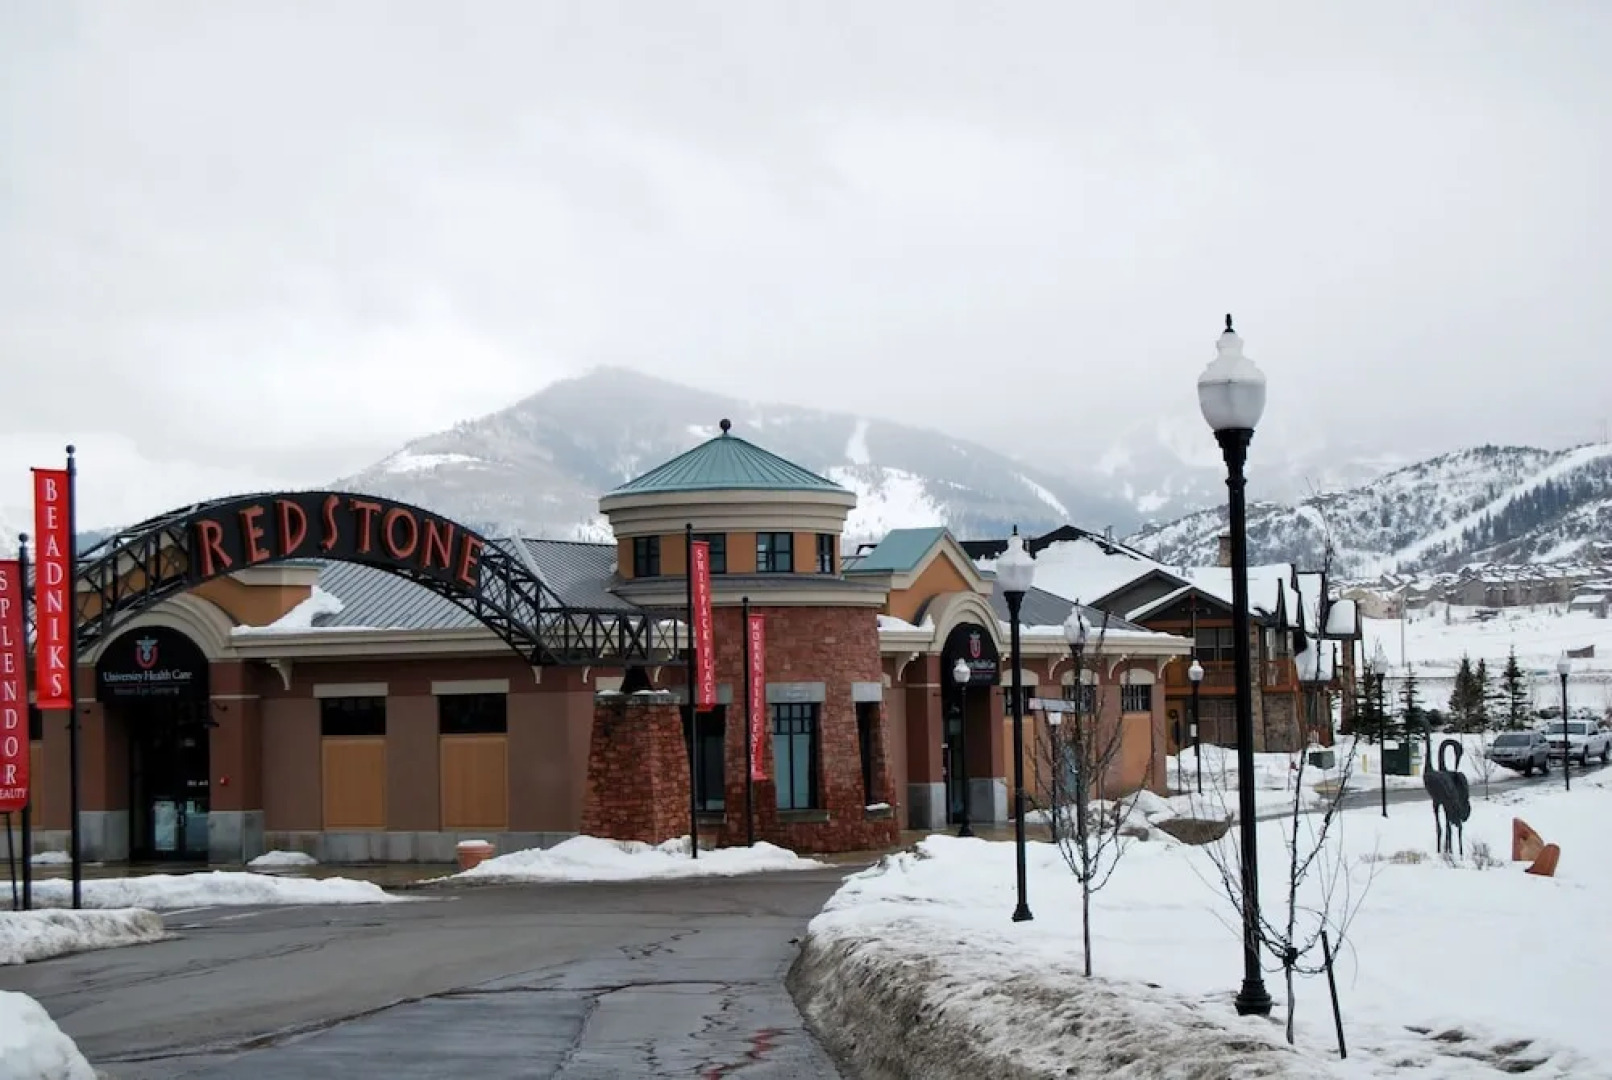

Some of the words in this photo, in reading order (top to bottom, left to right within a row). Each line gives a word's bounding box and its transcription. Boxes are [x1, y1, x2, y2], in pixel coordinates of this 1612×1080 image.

[196, 495, 485, 588] REDSTONE
[44, 477, 65, 697] BEADNIKS
[0, 570, 19, 785] SPLENDOR
[102, 671, 144, 682] University
[144, 669, 172, 681] Health
[172, 668, 193, 680] Care
[703, 647, 712, 705] PLACE
[0, 787, 27, 799] EAUTY
